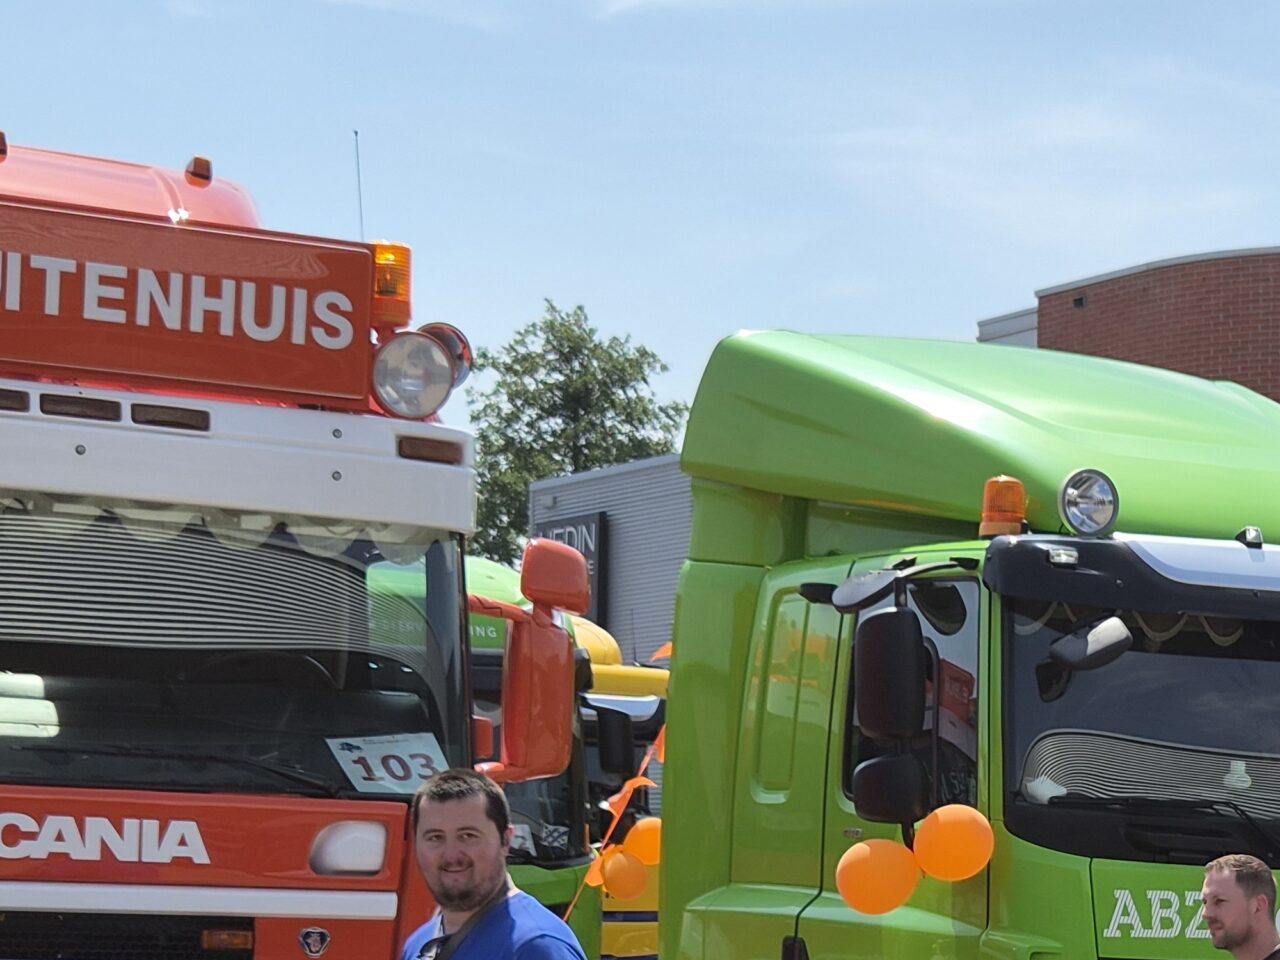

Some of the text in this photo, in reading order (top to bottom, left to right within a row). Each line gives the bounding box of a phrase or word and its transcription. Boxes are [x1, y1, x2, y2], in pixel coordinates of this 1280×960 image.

[0, 251, 354, 350] ITENHUIS
[352, 752, 441, 782] 103
[1103, 889, 1213, 939] ABZ
